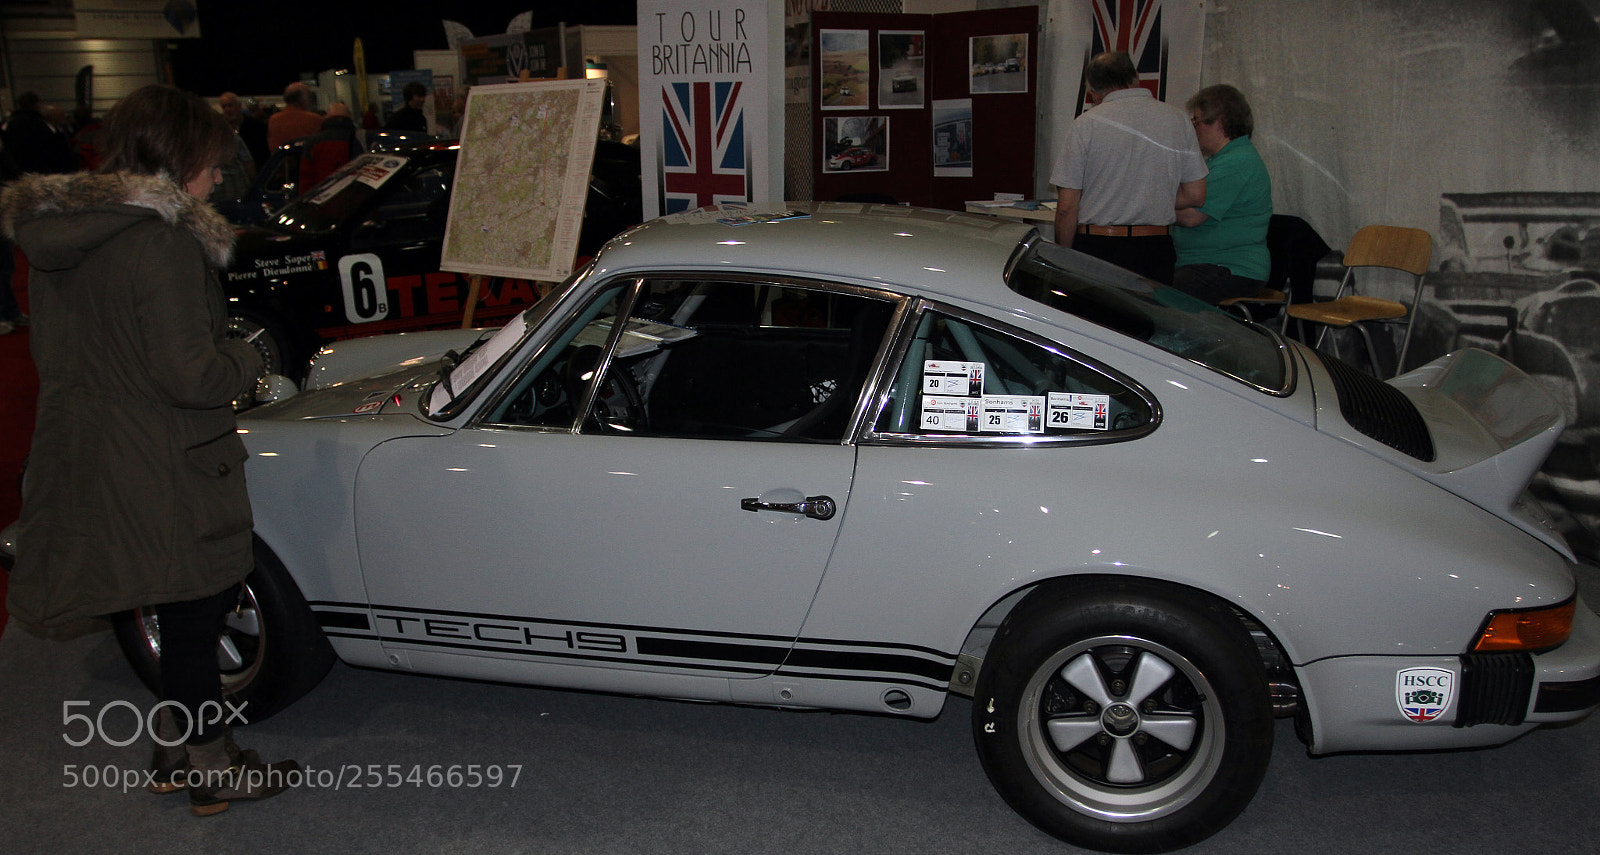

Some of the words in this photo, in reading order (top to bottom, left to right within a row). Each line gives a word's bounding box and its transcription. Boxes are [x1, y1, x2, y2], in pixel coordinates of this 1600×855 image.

[655, 8, 748, 44] TOUR
[652, 42, 752, 76] BRITANNIA
[254, 258, 280, 269] Steve
[284, 254, 312, 267] Soper
[227, 271, 258, 282] Pierre
[350, 261, 378, 319] 6
[387, 272, 543, 318] TEXA
[378, 303, 388, 314] B
[929, 378, 940, 389] 20
[926, 415, 940, 426] 40
[988, 414, 1001, 426] 25
[1052, 411, 1069, 424] 26
[376, 614, 627, 653] TECH9
[1404, 675, 1448, 688] HSCC
